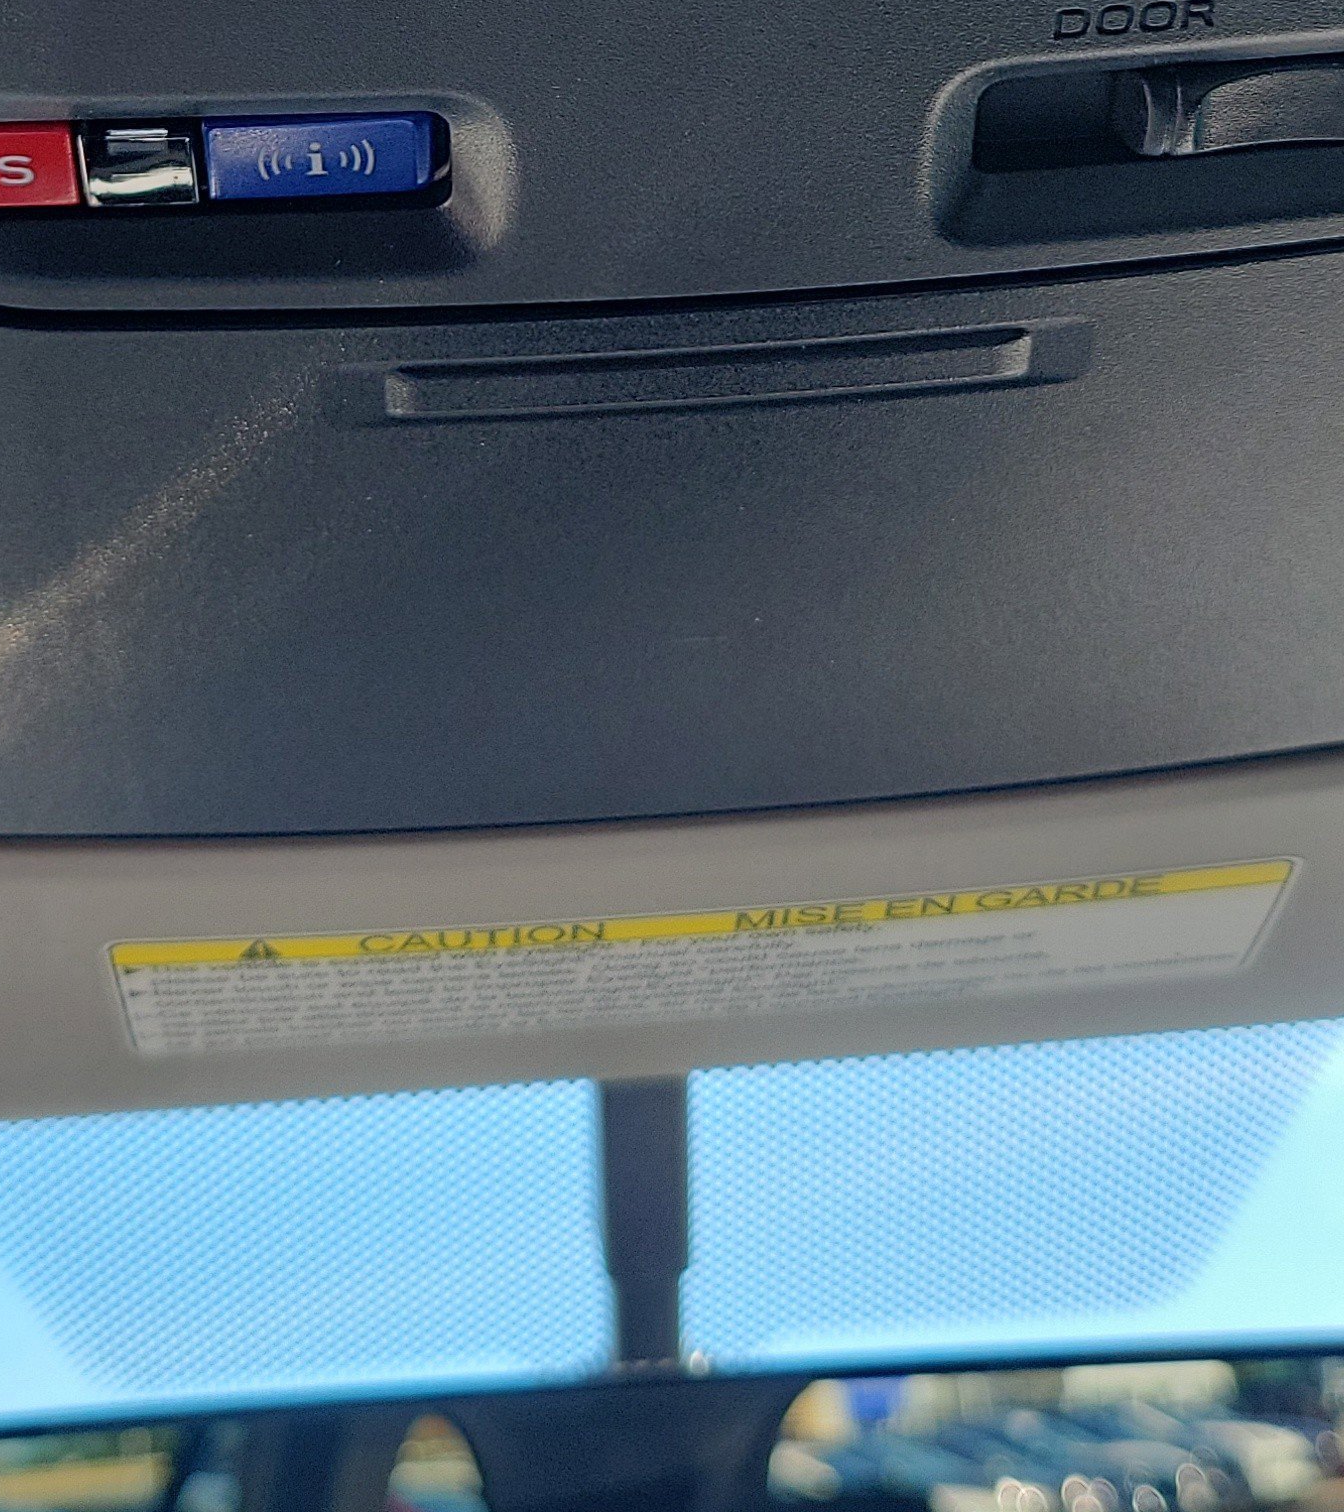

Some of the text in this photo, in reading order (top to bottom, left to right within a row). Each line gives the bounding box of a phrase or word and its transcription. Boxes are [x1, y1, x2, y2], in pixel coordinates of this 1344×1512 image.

[734, 877, 1164, 932] MISE EN GARDE
[358, 922, 607, 954] CAUTION
